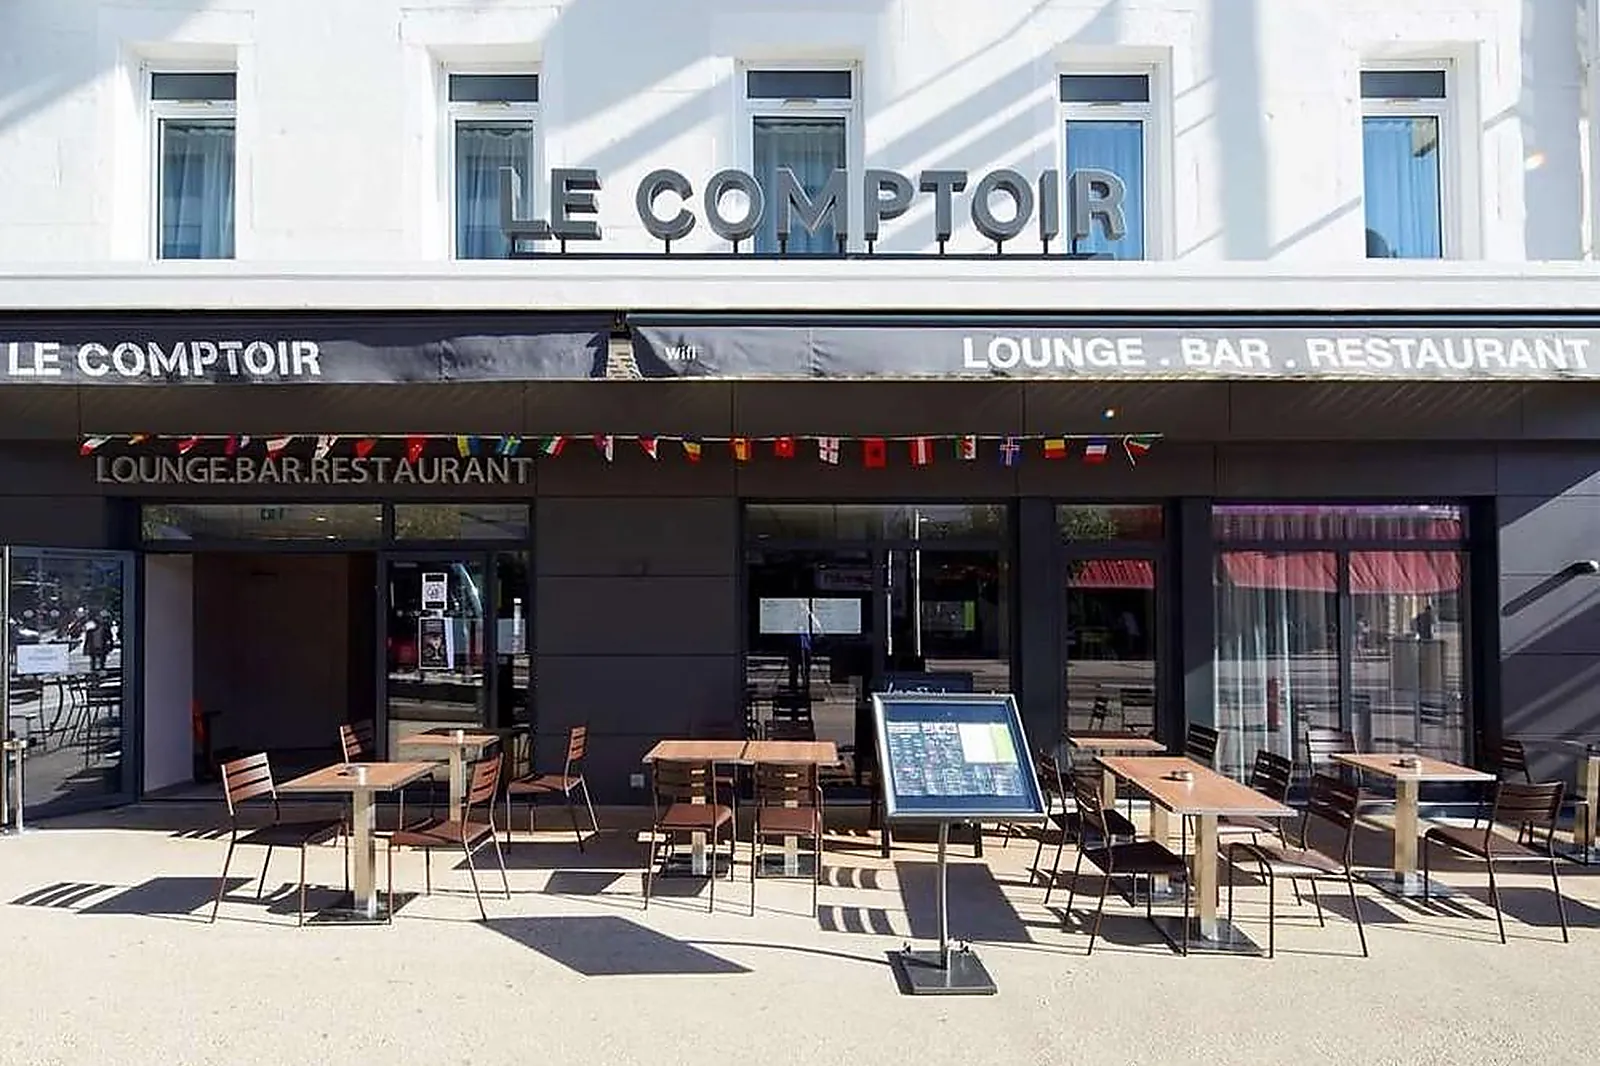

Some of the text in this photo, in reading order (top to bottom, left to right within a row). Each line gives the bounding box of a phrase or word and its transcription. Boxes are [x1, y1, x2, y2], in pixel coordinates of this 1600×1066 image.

[499, 166, 1126, 241] LE COMPTOIR
[8, 341, 321, 376] LE COMPTOIR
[963, 337, 1146, 369] LOUNGE
[1181, 337, 1271, 367] BAR
[1305, 337, 1590, 369] RESTAURANT
